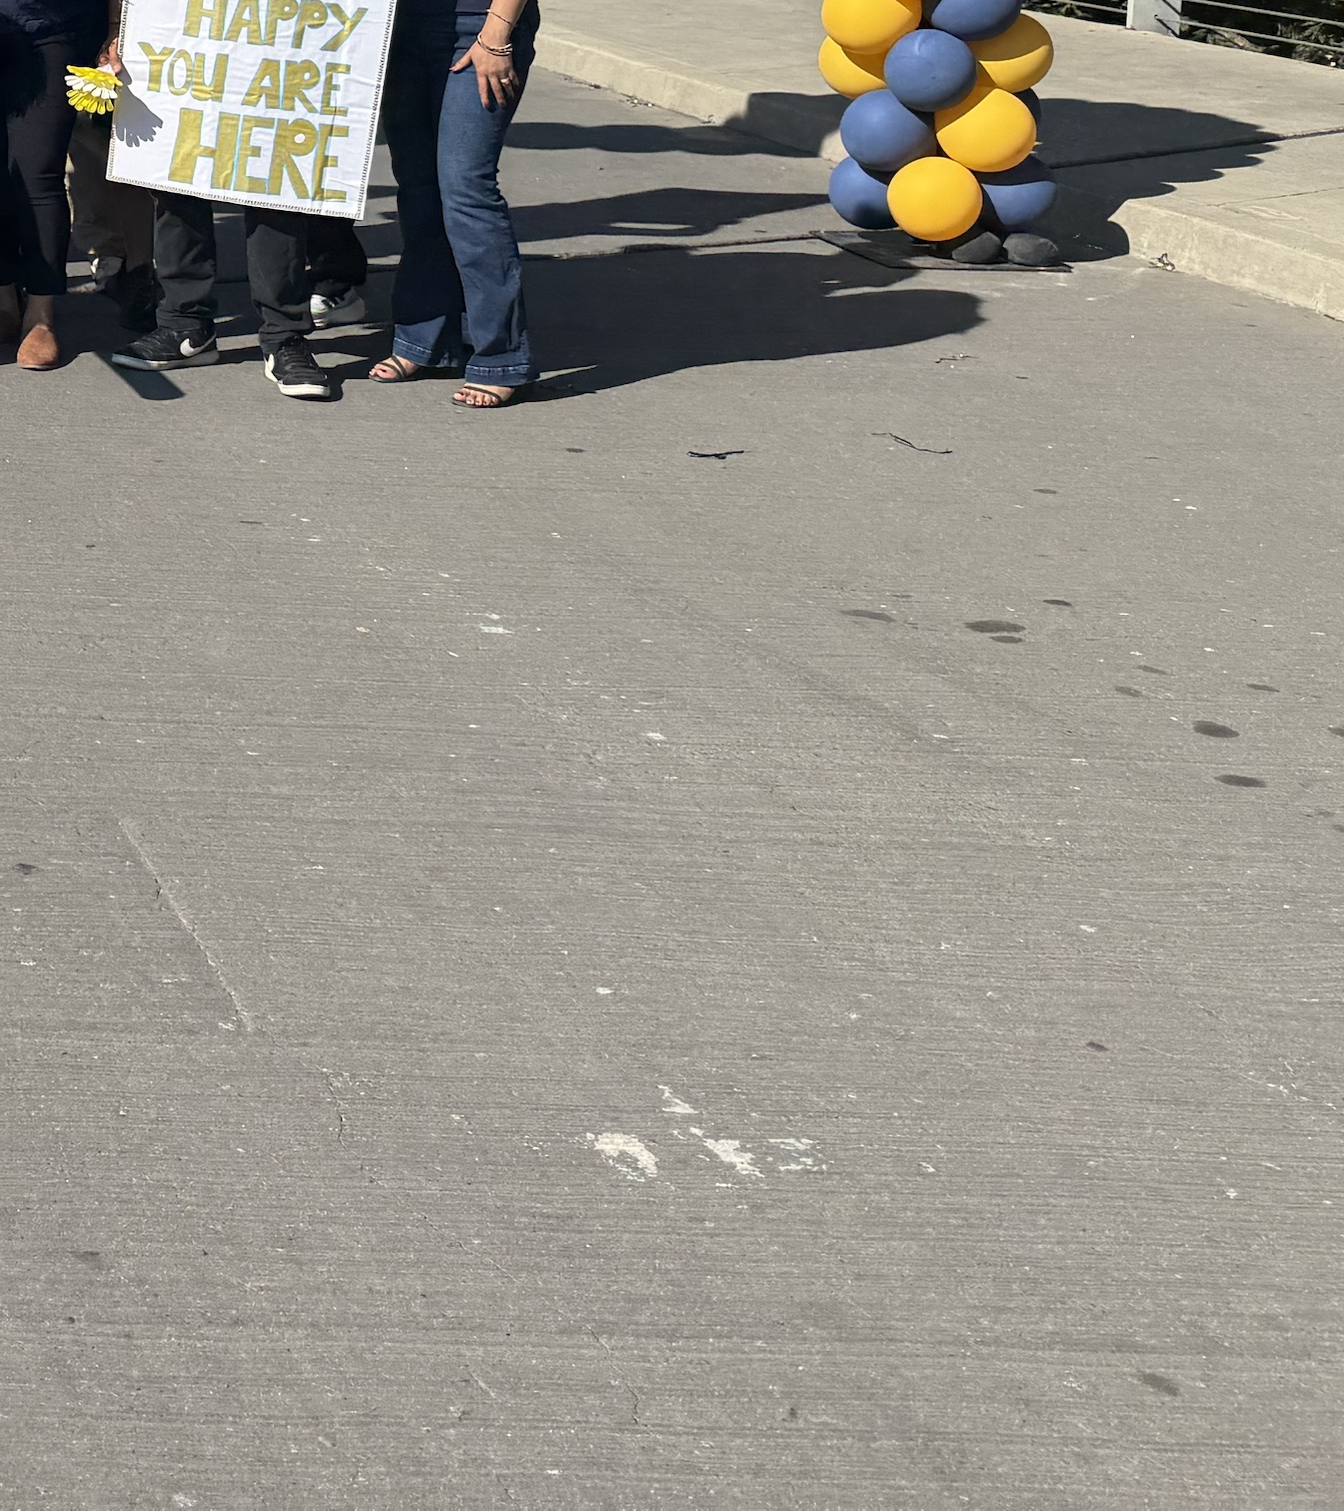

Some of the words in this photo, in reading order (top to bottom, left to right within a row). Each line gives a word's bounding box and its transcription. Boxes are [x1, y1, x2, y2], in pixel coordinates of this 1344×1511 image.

[137, 41, 230, 103] YOU
[241, 58, 351, 117] ARE
[167, 106, 350, 204] HERE
